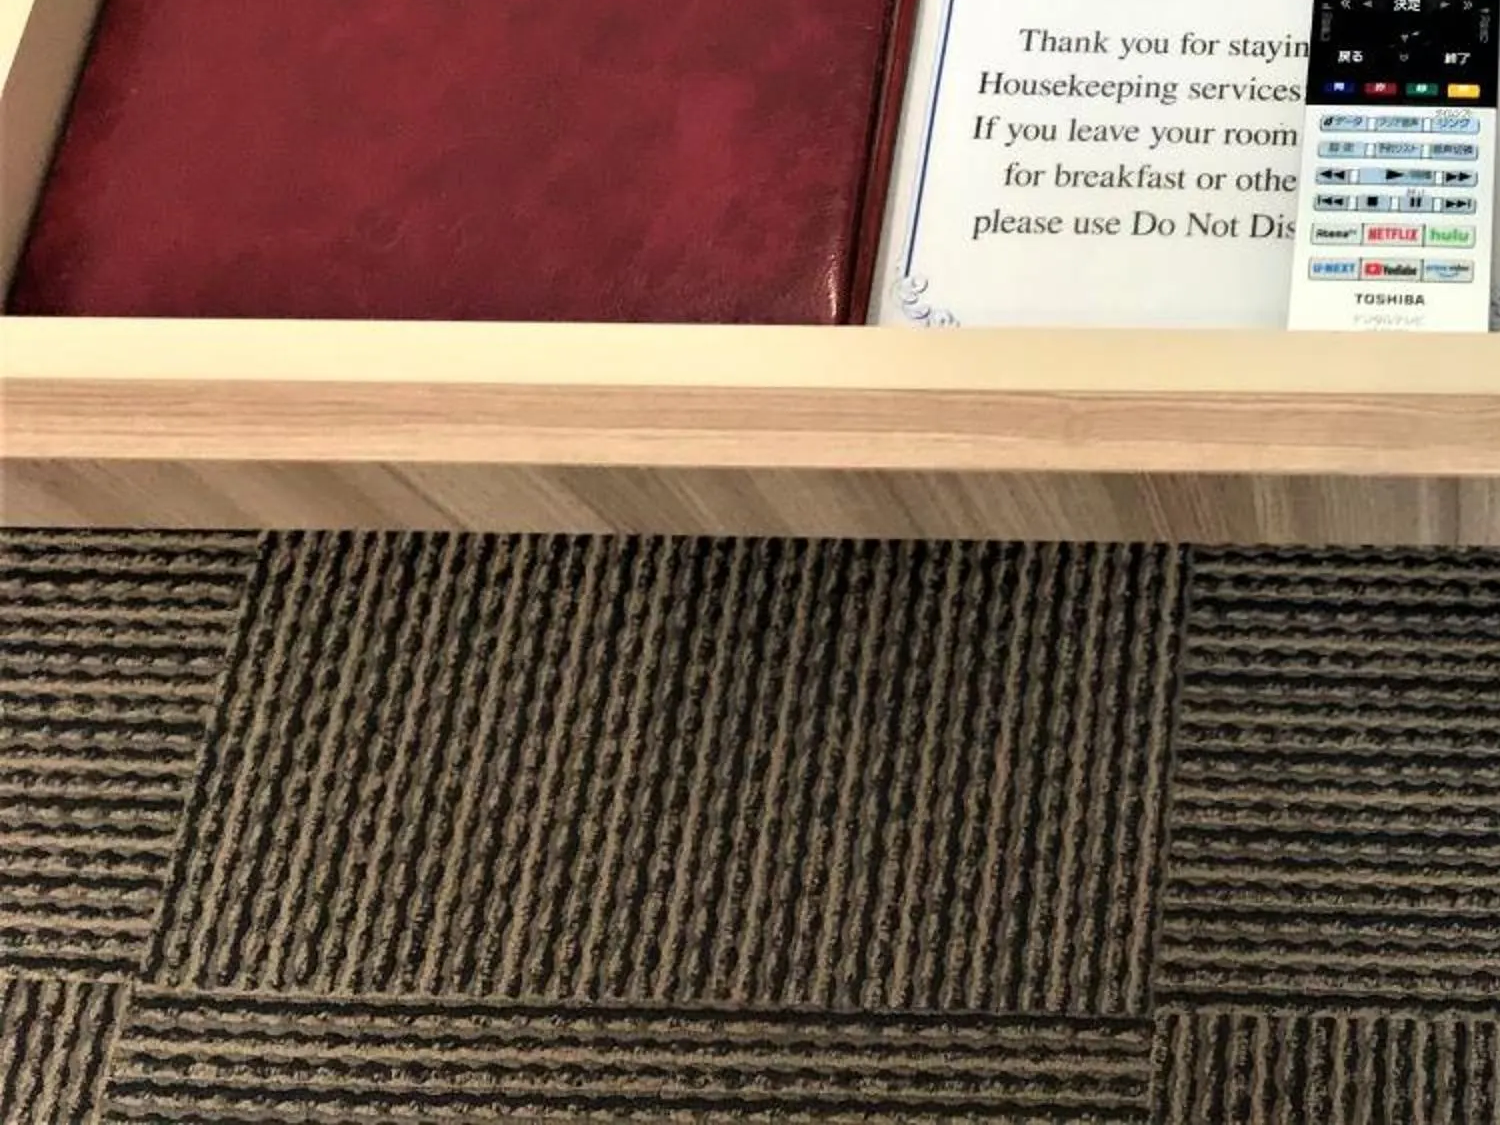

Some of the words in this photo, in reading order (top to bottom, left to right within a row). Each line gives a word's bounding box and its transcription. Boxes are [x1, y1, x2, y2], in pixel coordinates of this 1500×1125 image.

[1019, 29, 1109, 54] Thank
[1118, 35, 1169, 59] you
[1180, 32, 1220, 56] for
[977, 71, 1178, 105] Housekeeping
[1188, 76, 1301, 102] services
[973, 115, 999, 140] If
[1004, 121, 1056, 147] you
[1067, 118, 1139, 142] leave
[1149, 124, 1215, 149] your
[1223, 127, 1298, 146] room
[1003, 162, 1046, 188] for
[1055, 163, 1186, 190] breakfast
[1196, 172, 1227, 191] or
[972, 209, 1063, 240] please
[1074, 217, 1120, 236] use
[1131, 210, 1175, 237] Do
[1185, 211, 1240, 238] Not
[1368, 227, 1420, 241] NETFLIX
[1430, 228, 1470, 241] hulu
[1354, 293, 1426, 306] TOSHIBA
